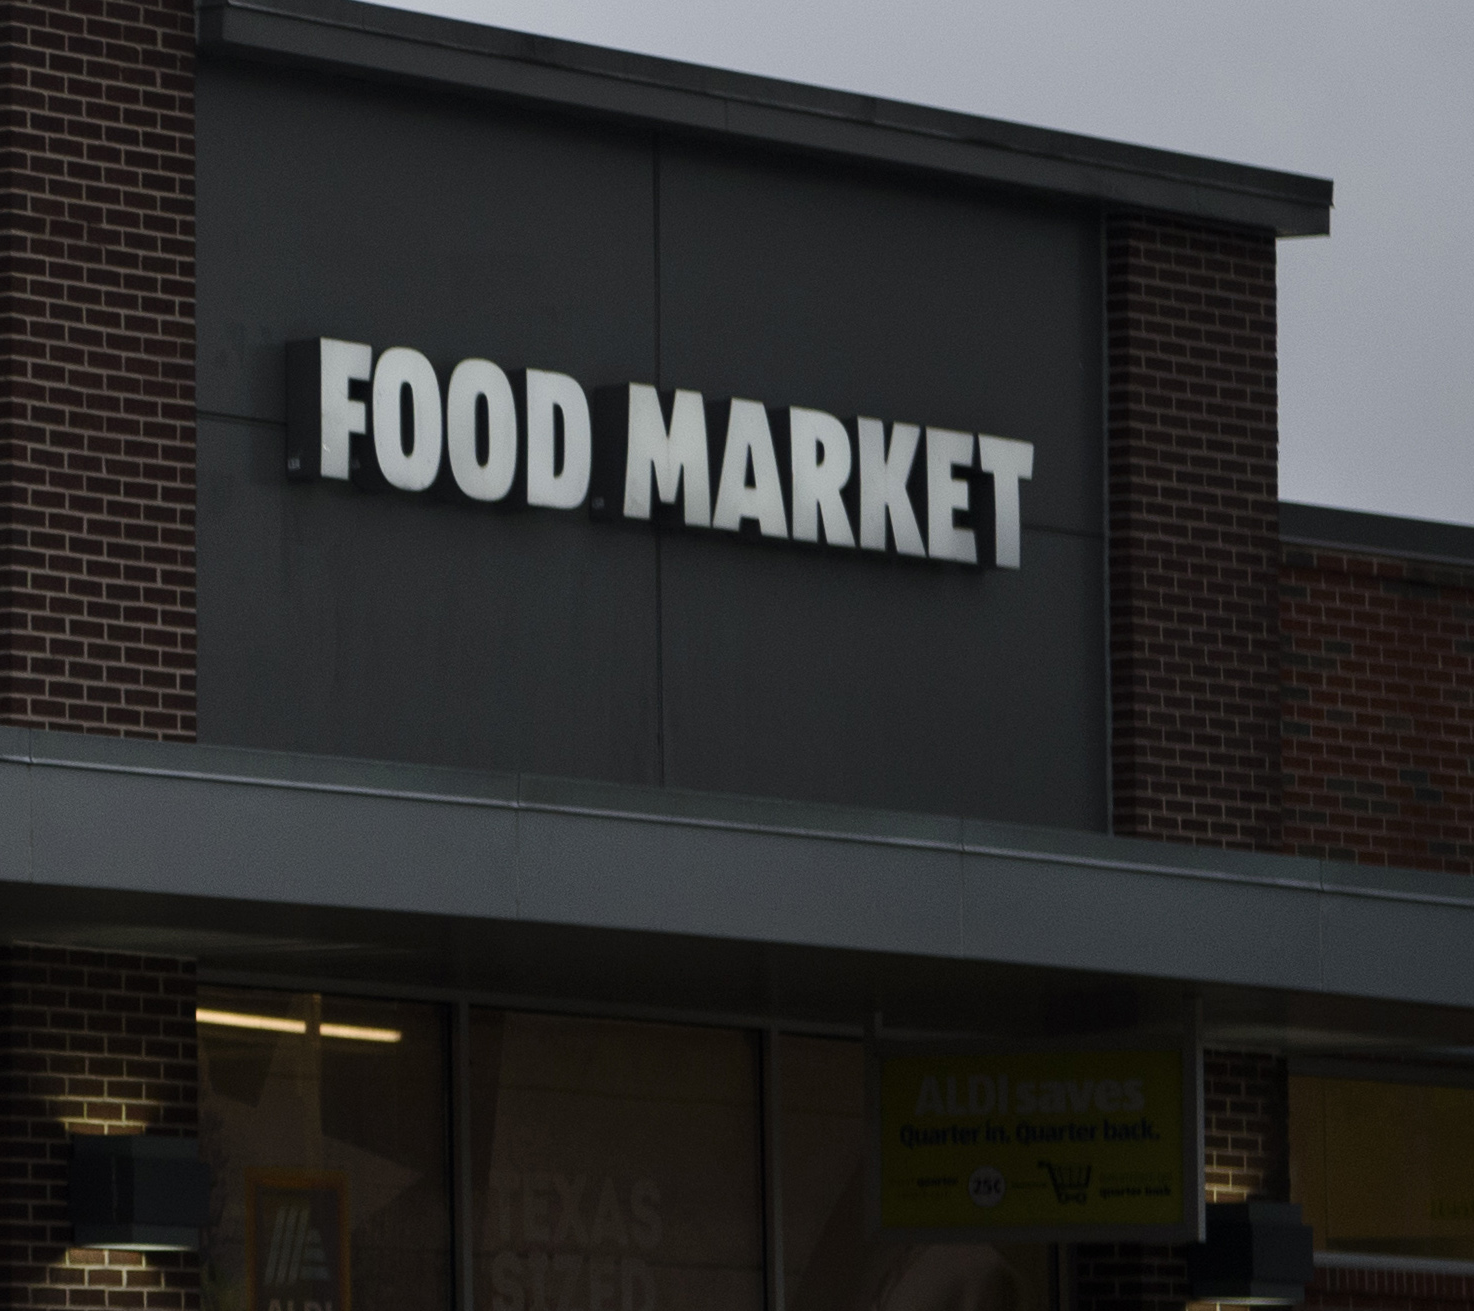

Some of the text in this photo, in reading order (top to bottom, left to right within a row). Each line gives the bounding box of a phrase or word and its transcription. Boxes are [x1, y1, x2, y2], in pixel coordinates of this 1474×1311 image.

[320, 336, 1035, 571] FOOD MARKET
[914, 1074, 1146, 1117] ALDI saves
[900, 1118, 1160, 1148] Quarter in. Quarter back.
[487, 1172, 663, 1249] TEXAS
